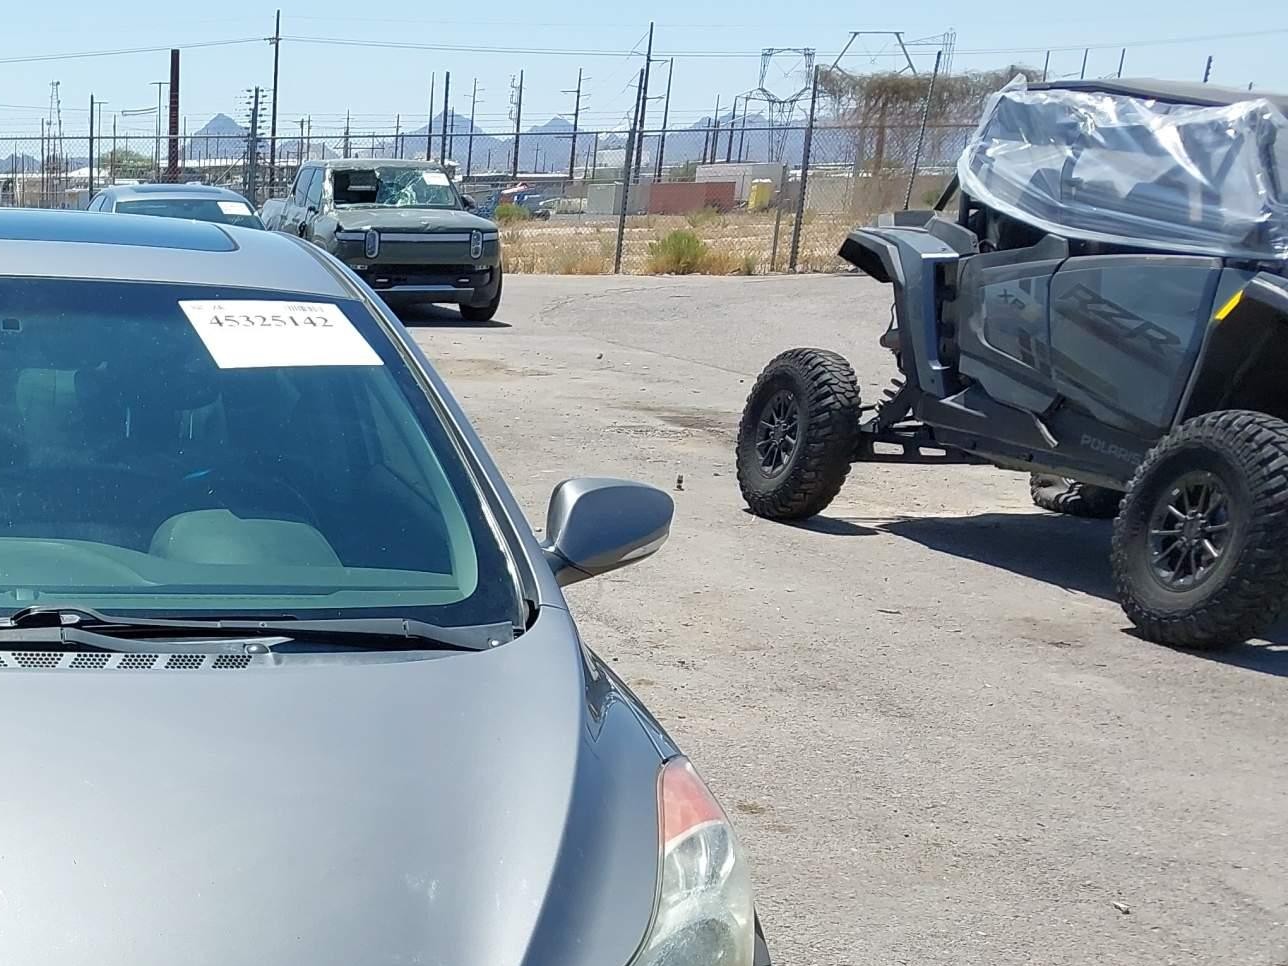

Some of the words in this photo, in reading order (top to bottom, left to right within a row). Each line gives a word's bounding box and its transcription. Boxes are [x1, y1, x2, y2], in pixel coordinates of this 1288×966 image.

[208, 315, 334, 328] 45325142
[1058, 282, 1182, 350] RZR
[1079, 434, 1143, 466] POLARIS
